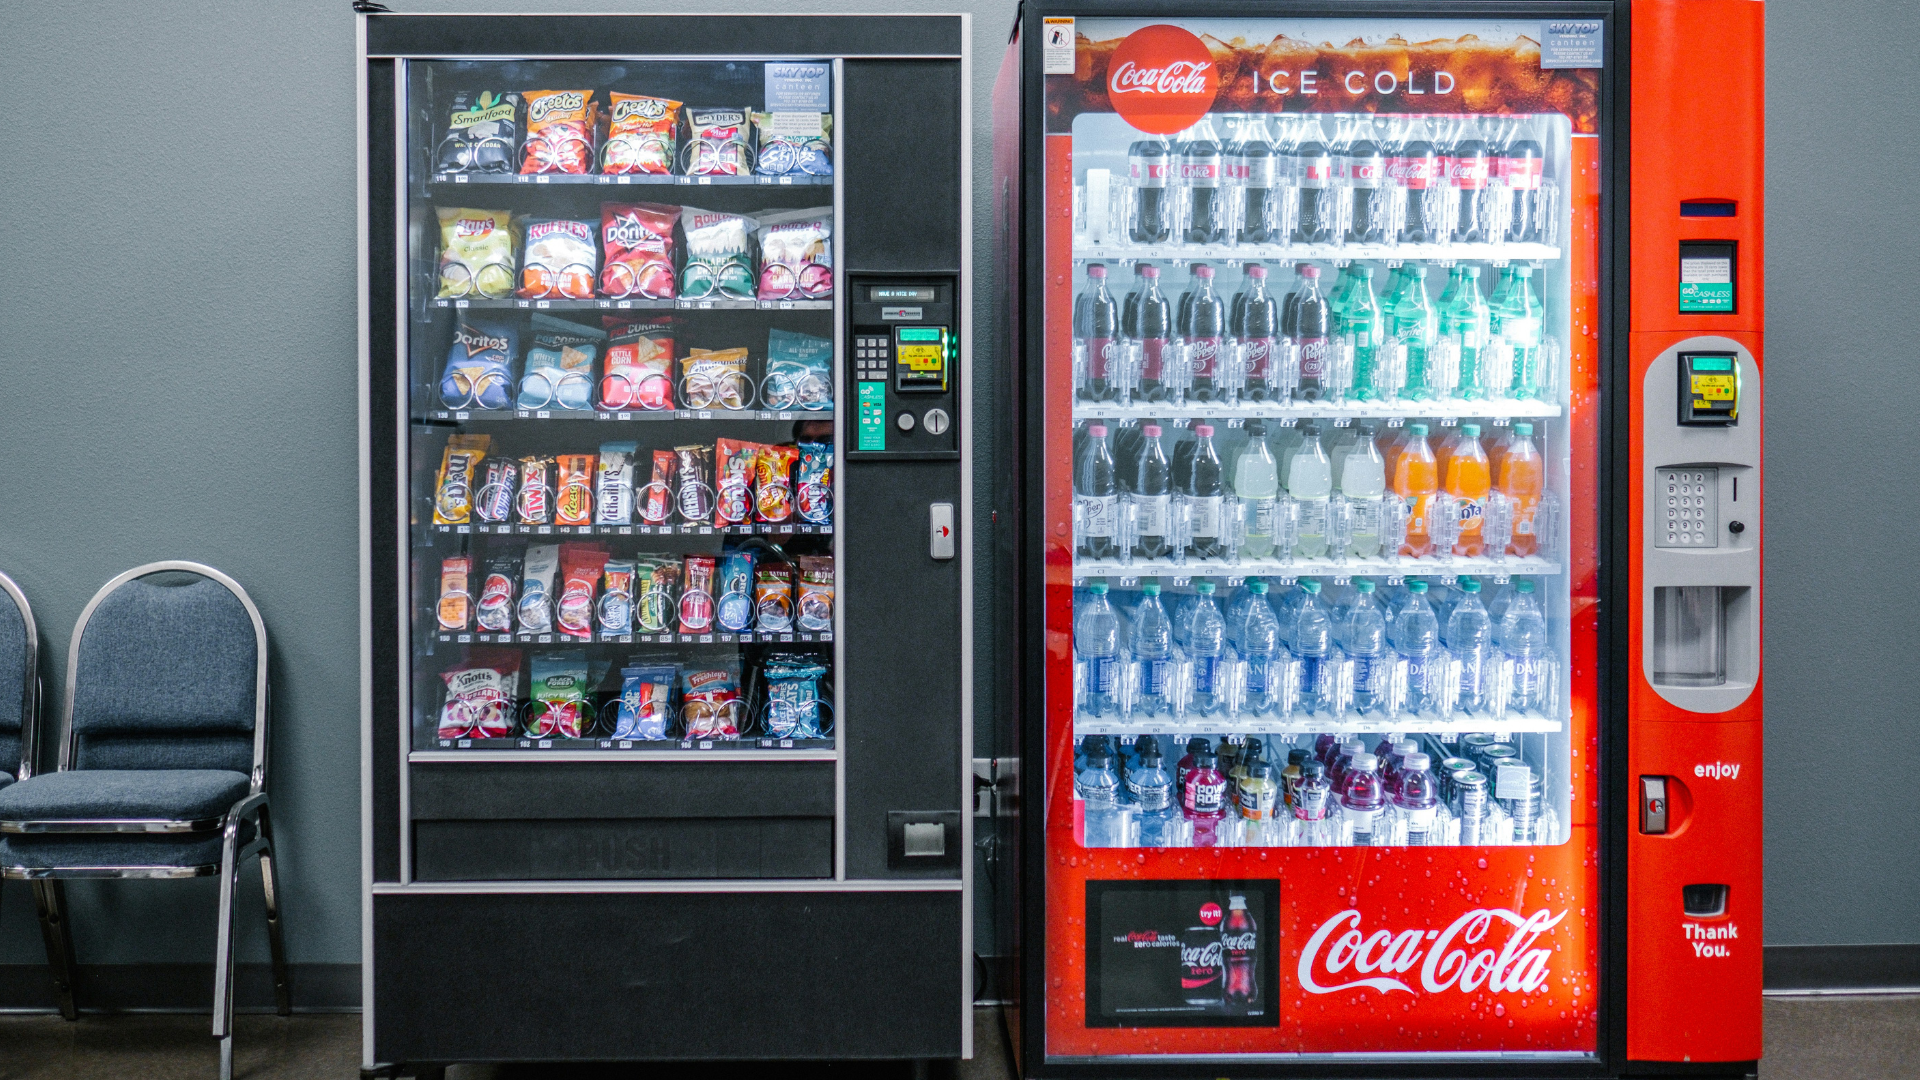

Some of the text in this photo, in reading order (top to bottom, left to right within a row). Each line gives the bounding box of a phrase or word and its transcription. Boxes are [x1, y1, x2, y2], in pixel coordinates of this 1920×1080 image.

[1549, 23, 1599, 34] SKY TOP
[773, 67, 826, 79] SKY TOP
[1111, 61, 1212, 94] Coca-Cola
[775, 83, 820, 91] canteen
[1253, 71, 1455, 95] ICE COLD
[531, 93, 583, 122] Cheetos
[613, 100, 668, 121] Cheetos
[454, 109, 511, 125] Smartfood
[1182, 165, 1210, 178] Coke
[457, 218, 493, 237] Lay's
[529, 221, 589, 241] RUFFLES
[464, 244, 489, 252] Classic
[1682, 287, 1730, 298] GO CASHLESS
[1397, 326, 1424, 340] Sprite
[533, 353, 556, 363] WHITE
[611, 350, 632, 358] KETTLE
[611, 357, 632, 365] CORN
[1696, 474, 1702, 482] 2
[1460, 503, 1482, 520] nta
[1669, 533, 1674, 541] F
[456, 673, 492, 689] Knott's
[691, 671, 727, 684] Freshley's
[1694, 762, 1740, 780] enjoy
[1200, 910, 1212, 918] try
[1682, 923, 1738, 939] Thank
[1113, 934, 1128, 943] real
[1157, 934, 1176, 942] taste
[1151, 940, 1180, 948] calories
[1298, 908, 1568, 994] Coca-Cola
[1692, 942, 1730, 957] You.
[1191, 966, 1214, 976] zero
